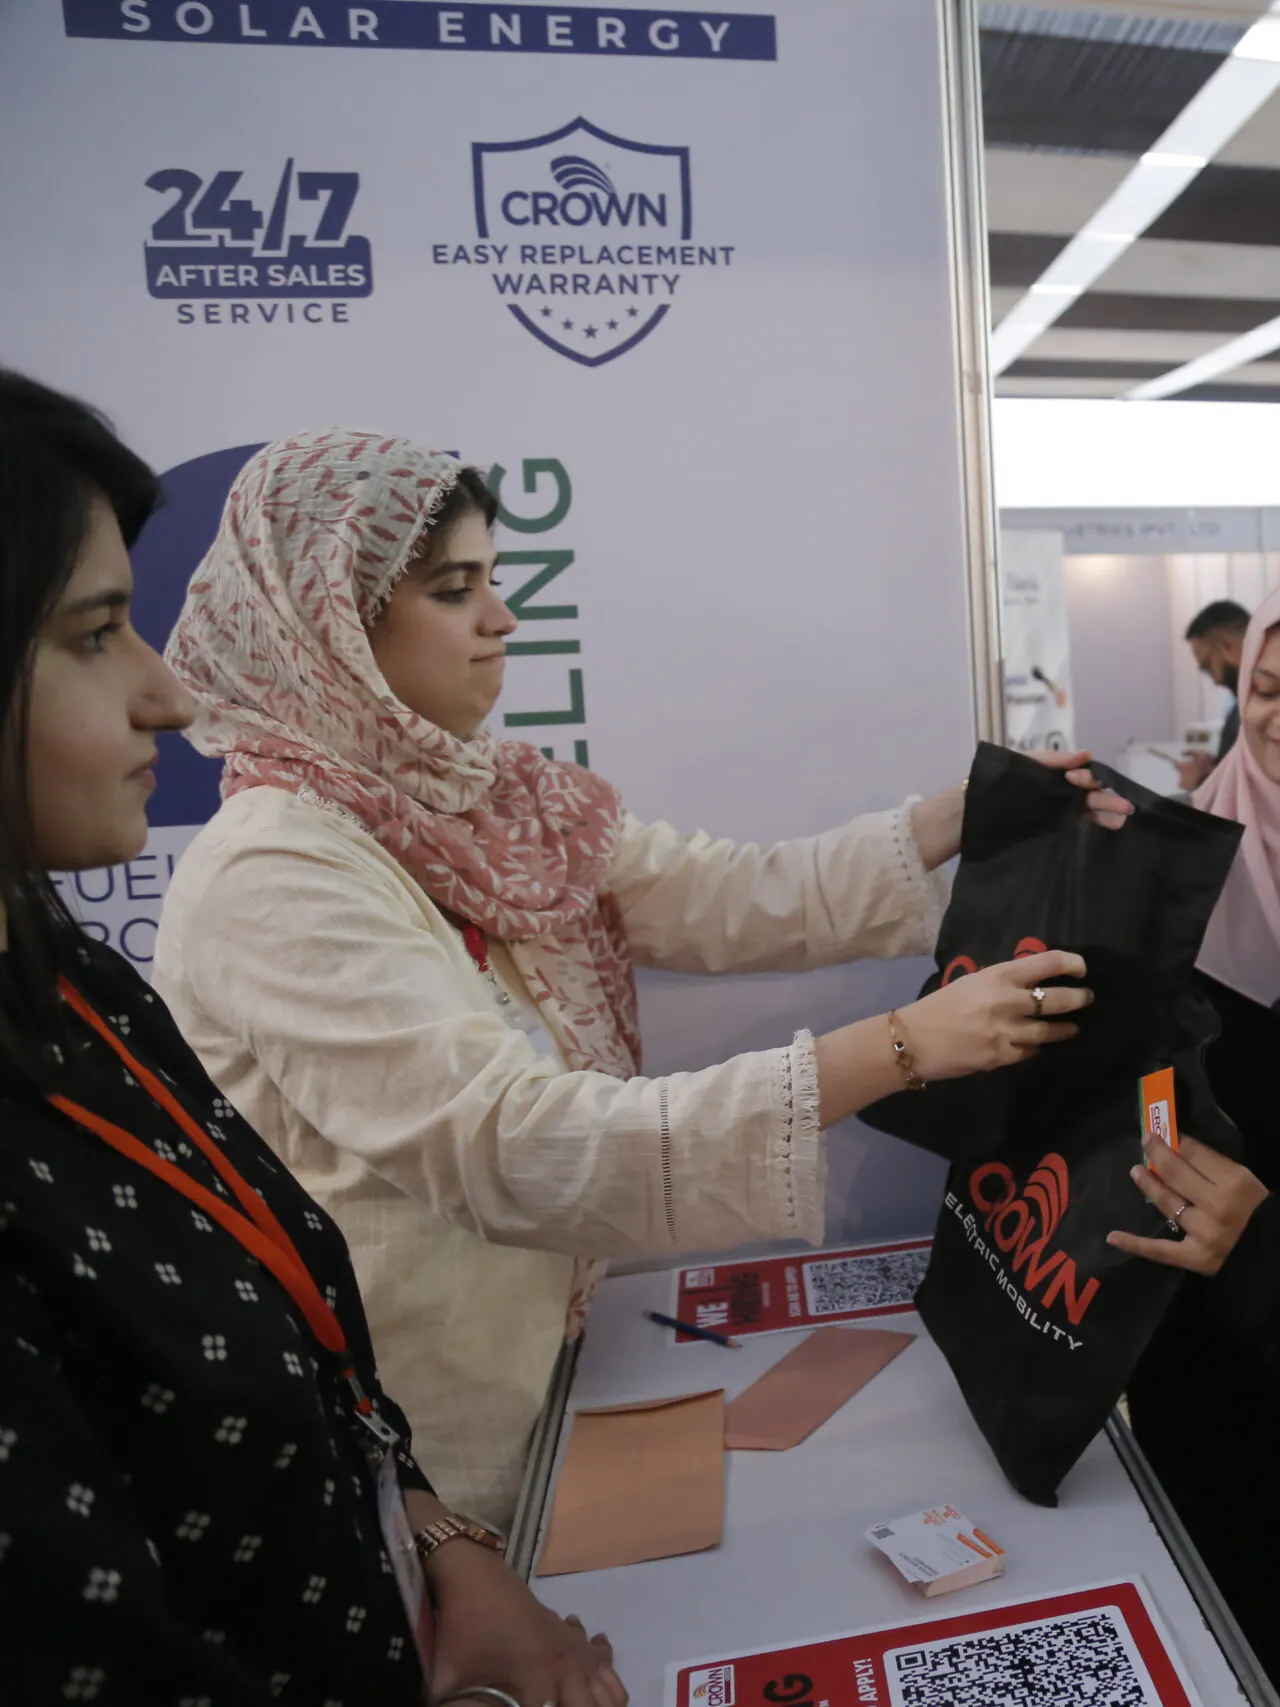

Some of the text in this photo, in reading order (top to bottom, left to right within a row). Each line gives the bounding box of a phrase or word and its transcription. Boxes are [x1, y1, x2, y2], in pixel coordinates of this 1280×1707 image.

[120, 0, 730, 52] SOLAR ENERGY
[144, 157, 360, 252] 24/7
[501, 190, 668, 227] CROWN
[432, 244, 735, 266] EASY REPLACEMENT
[156, 264, 366, 287] AFTER SALES
[492, 273, 680, 295] WARRANTY
[176, 302, 350, 325] SERVICE
[696, 1301, 729, 1329] WE
[996, 1268, 1083, 1350] MOBILITY
[708, 1668, 724, 1707] CROWN
[852, 1657, 878, 1702] APPLY!
